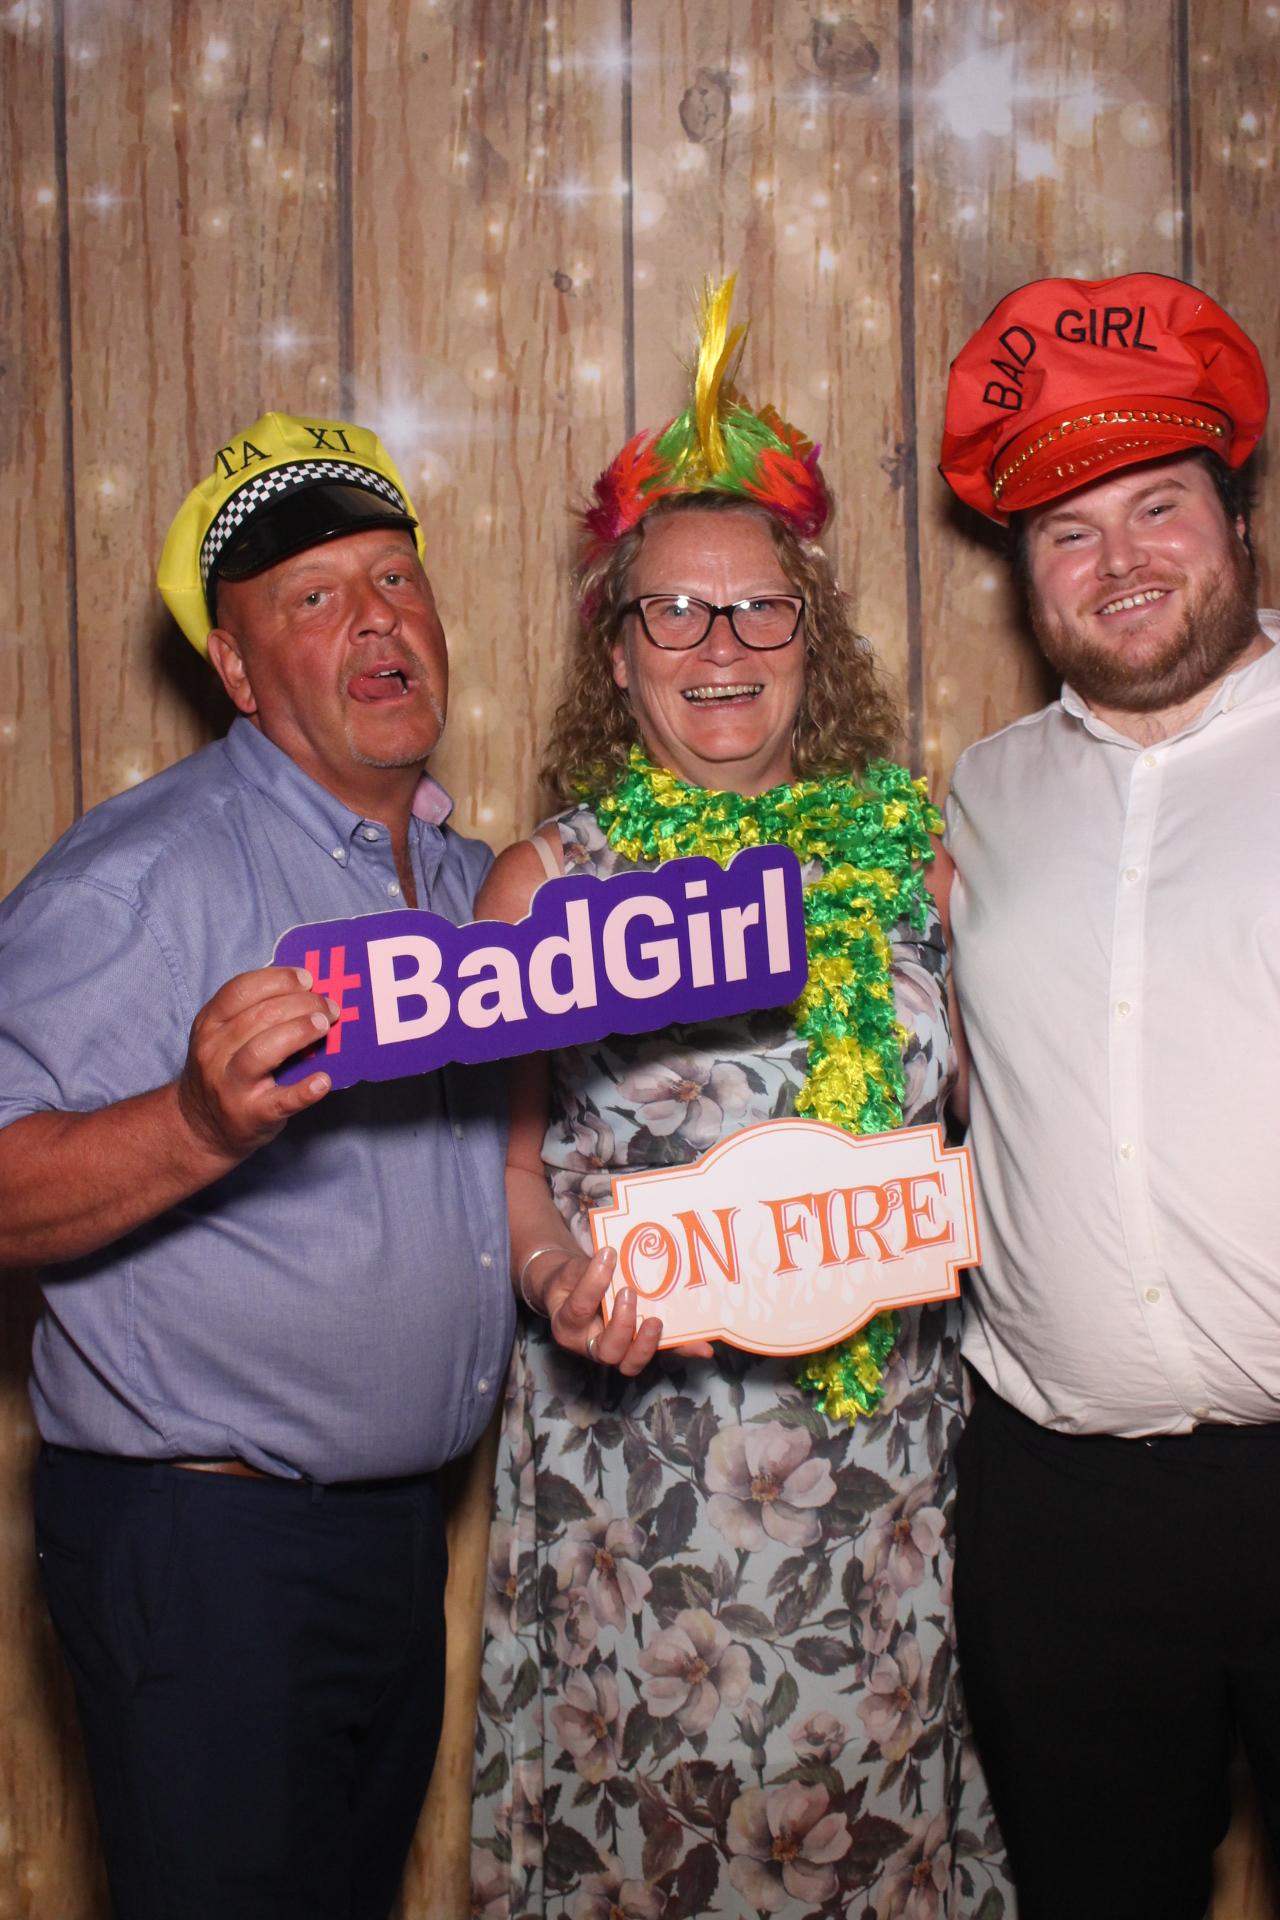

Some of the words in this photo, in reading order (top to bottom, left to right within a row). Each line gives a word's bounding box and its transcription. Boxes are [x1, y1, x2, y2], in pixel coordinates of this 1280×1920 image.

[982, 326, 1037, 411] BAD
[1055, 306, 1158, 352] GIRL
[303, 867, 791, 1055] #BadGirl
[619, 1206, 742, 1301] ON
[758, 1170, 955, 1276] FIRE
